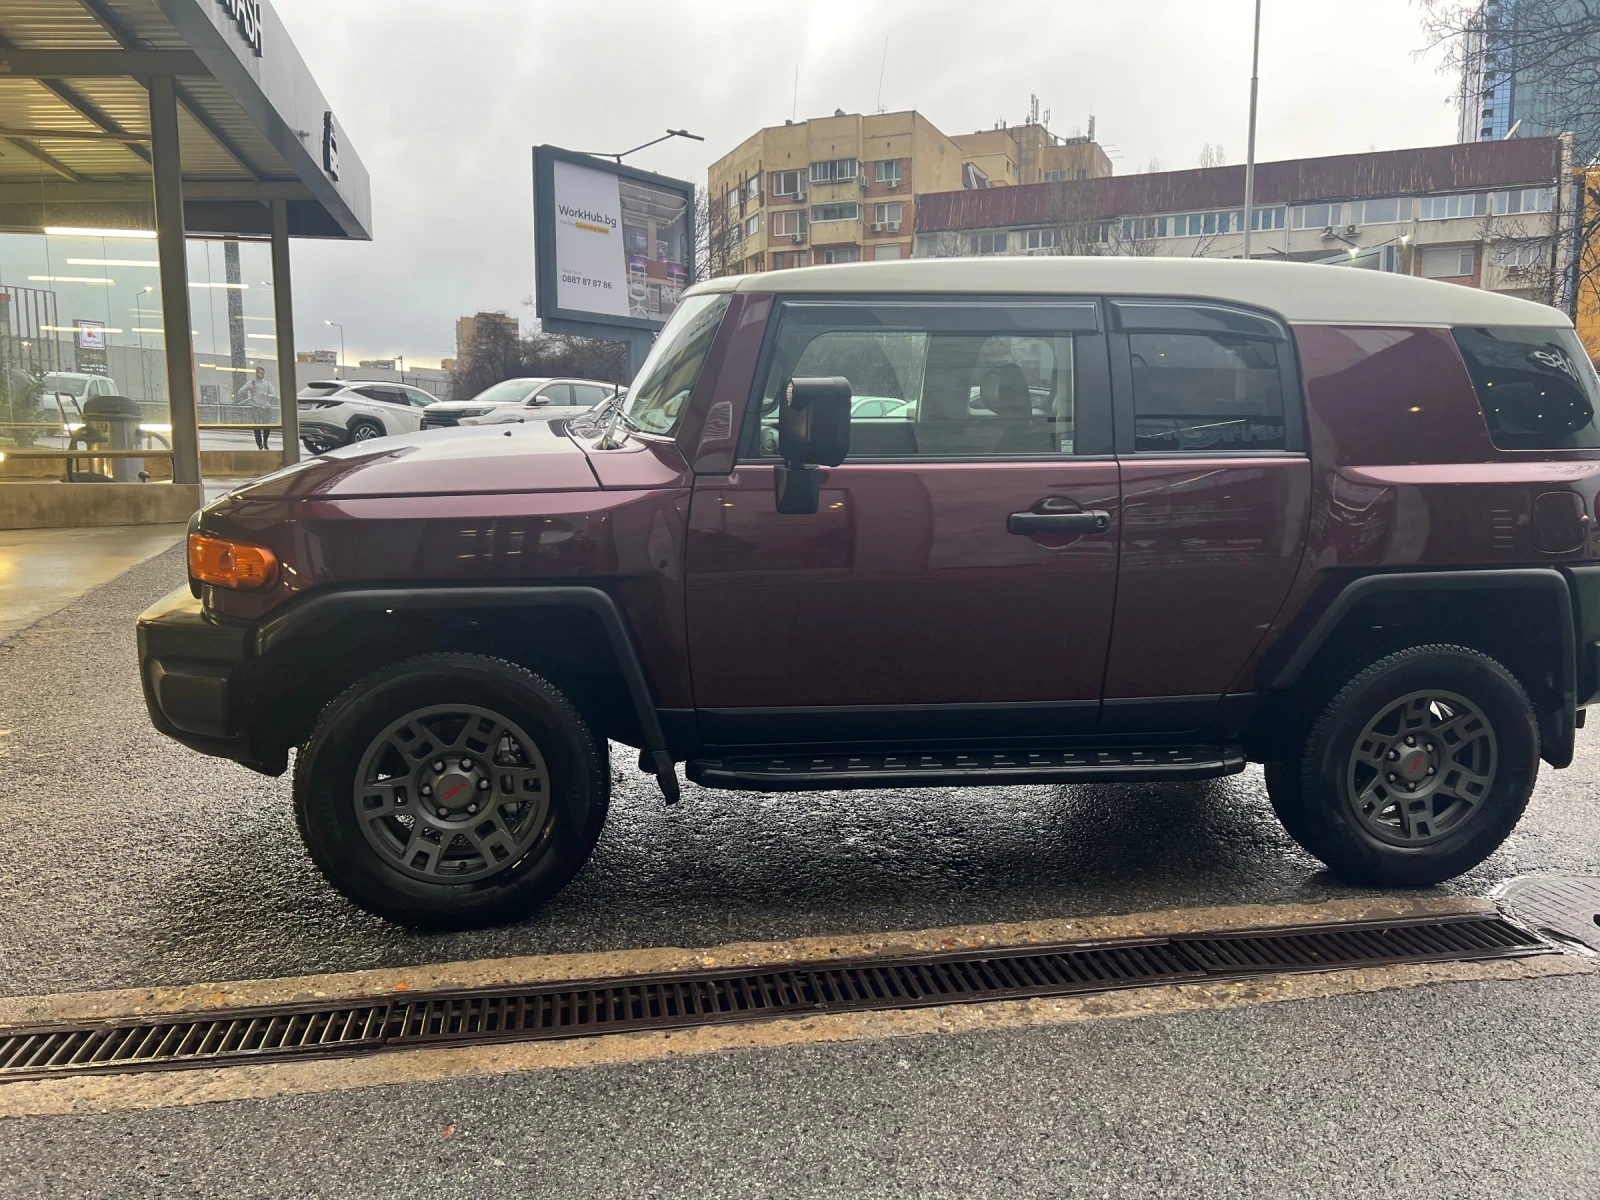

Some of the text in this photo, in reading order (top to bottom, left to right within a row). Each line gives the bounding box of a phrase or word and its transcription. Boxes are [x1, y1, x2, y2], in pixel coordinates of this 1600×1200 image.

[558, 204, 617, 228] WorkHub.bg
[562, 274, 612, 289] 0887 87 87 86
